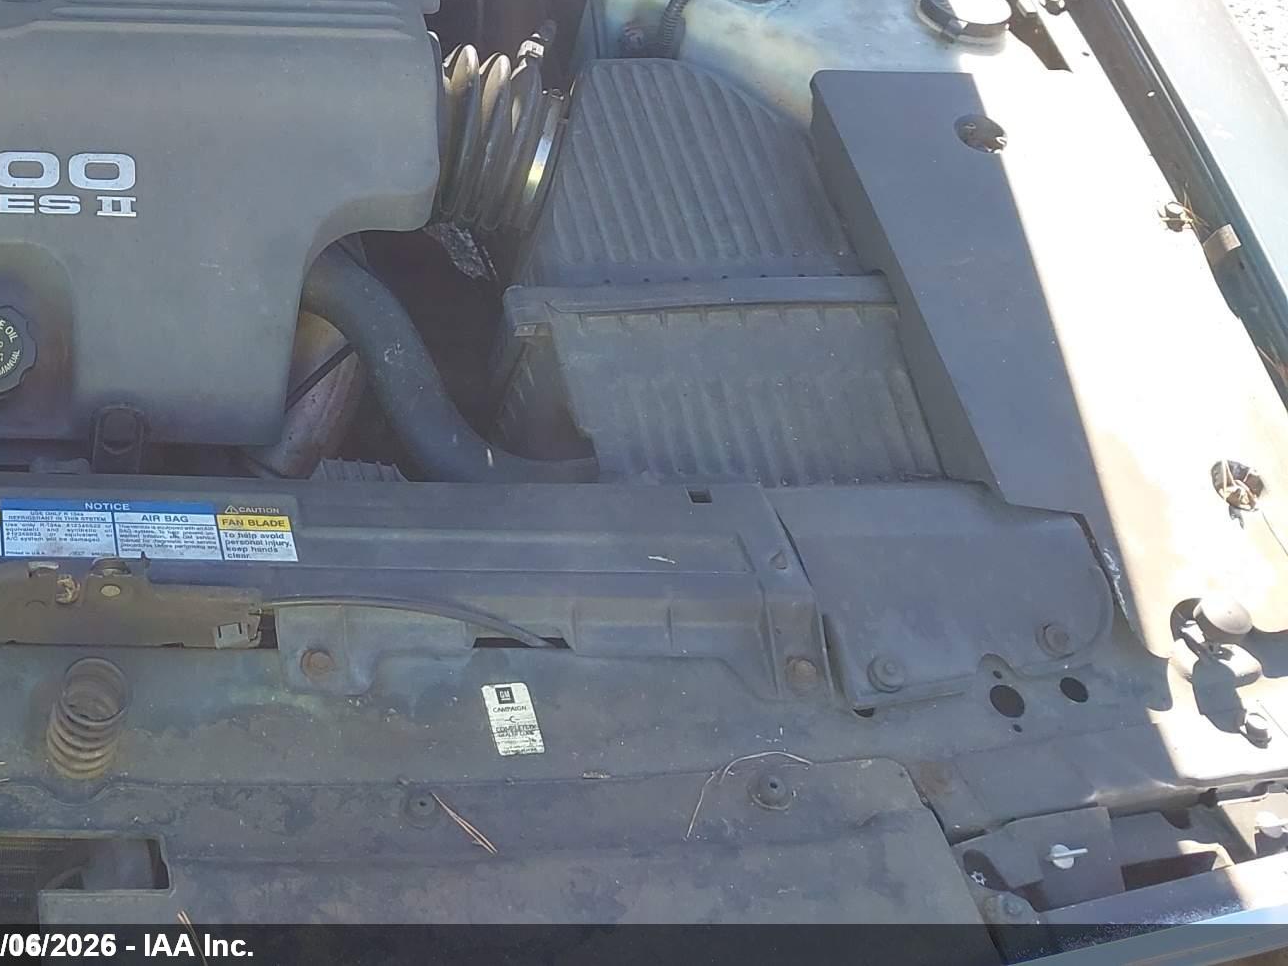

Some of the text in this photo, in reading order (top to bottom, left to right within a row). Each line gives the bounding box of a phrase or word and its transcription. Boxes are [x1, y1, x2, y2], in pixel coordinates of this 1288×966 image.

[95, 195, 137, 218] II
[5, 325, 18, 343] OIL
[84, 502, 131, 511] NOTICE
[226, 545, 248, 553] keep
